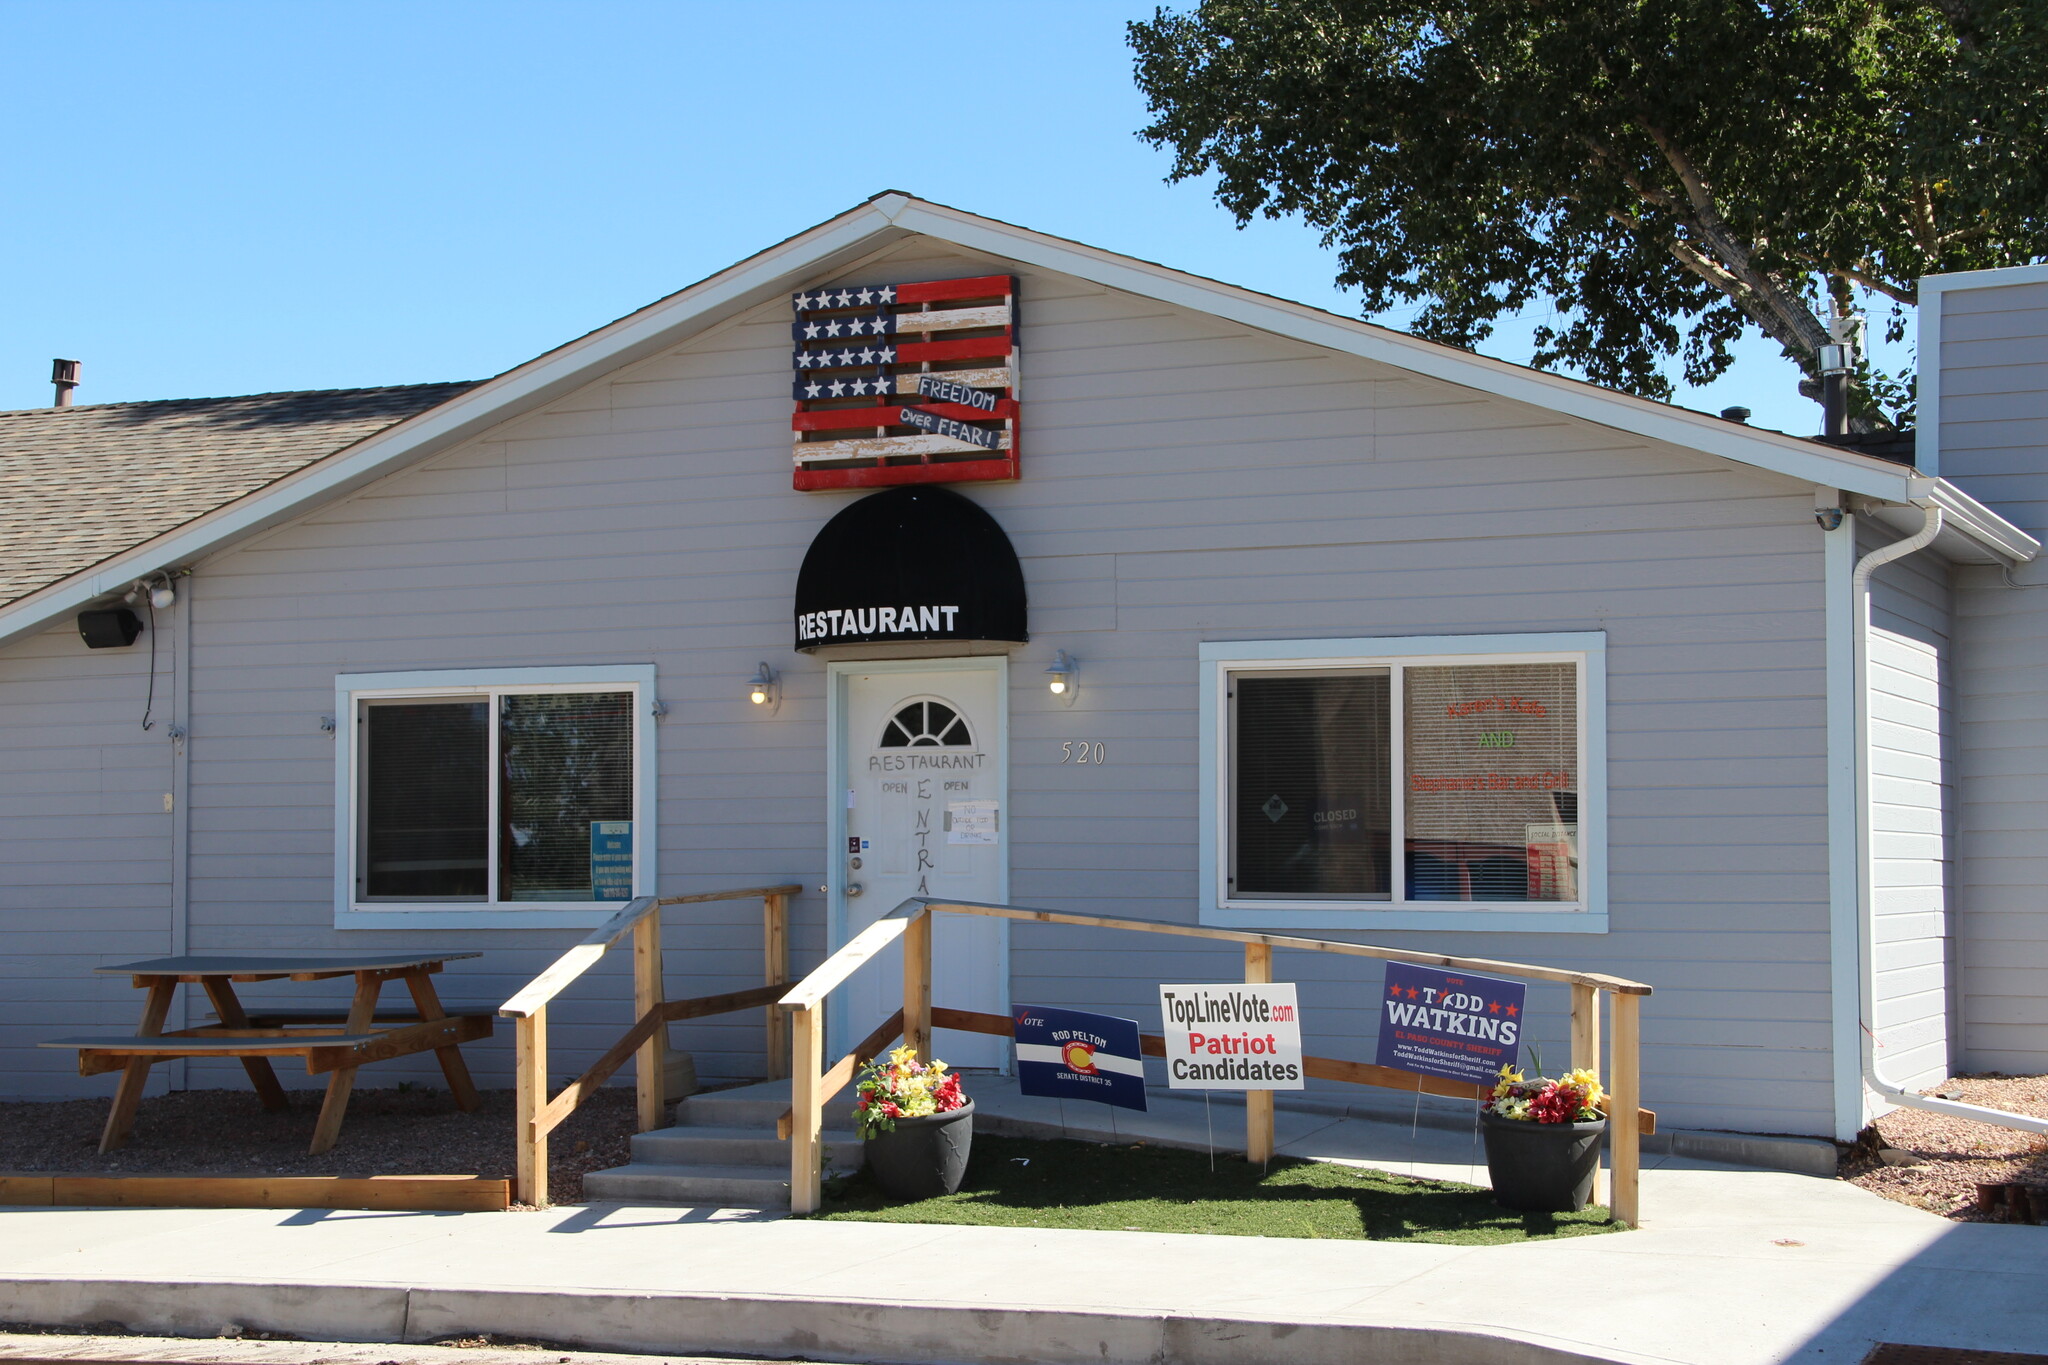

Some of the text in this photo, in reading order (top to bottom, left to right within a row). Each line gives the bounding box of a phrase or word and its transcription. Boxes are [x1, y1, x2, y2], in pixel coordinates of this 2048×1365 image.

[919, 376, 995, 412] FREEDOM
[900, 408, 992, 447] OVER FEAR!
[799, 606, 959, 641] RESTAURANT
[1447, 696, 1546, 719] Karen's Kafe
[1479, 731, 1515, 748] AND
[869, 754, 985, 771] RESTAURANT
[1061, 741, 1105, 765] 520
[882, 782, 908, 794] OPEN
[944, 781, 969, 791] OPEN
[1487, 773, 1509, 790] Bar
[1515, 773, 1538, 790] and
[964, 805, 977, 815] NO
[1313, 808, 1357, 823] CLOSED
[1164, 991, 1294, 1031] TopLineVote.com
[1386, 1000, 1518, 1046] WATKINS
[1052, 1030, 1107, 1048] ROD PELTON
[1188, 1032, 1277, 1055] Patriot
[1395, 1030, 1503, 1056] EL PASO COUNTY SHERIFF
[1080, 1075, 1103, 1084] DISTRICT
[1104, 1079, 1112, 1087] 35
[1173, 1058, 1299, 1081] Candidates
